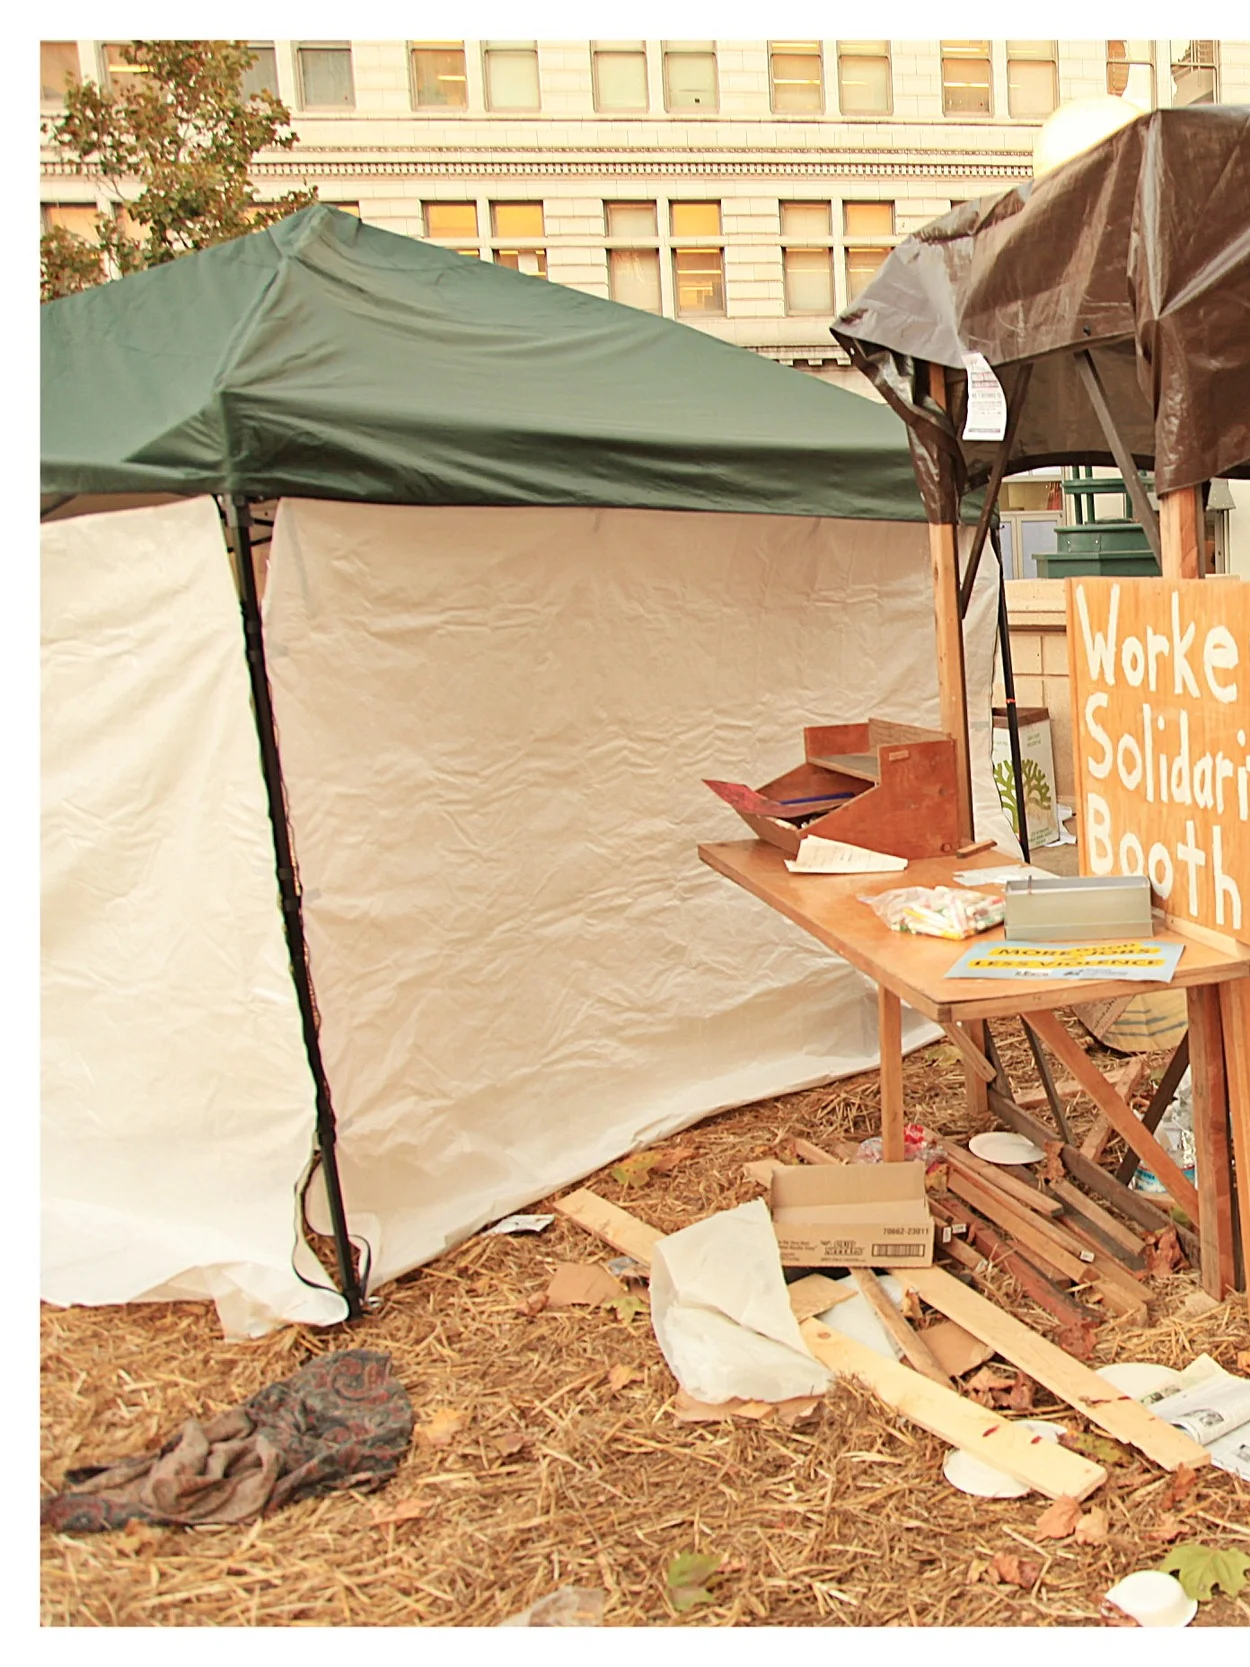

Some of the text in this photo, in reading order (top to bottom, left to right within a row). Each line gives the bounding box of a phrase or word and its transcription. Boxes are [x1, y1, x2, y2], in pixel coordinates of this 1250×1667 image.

[1086, 792, 1242, 931] Booth
[998, 948, 1072, 956] MORE
[1039, 959, 1160, 968] VIOLENCE
